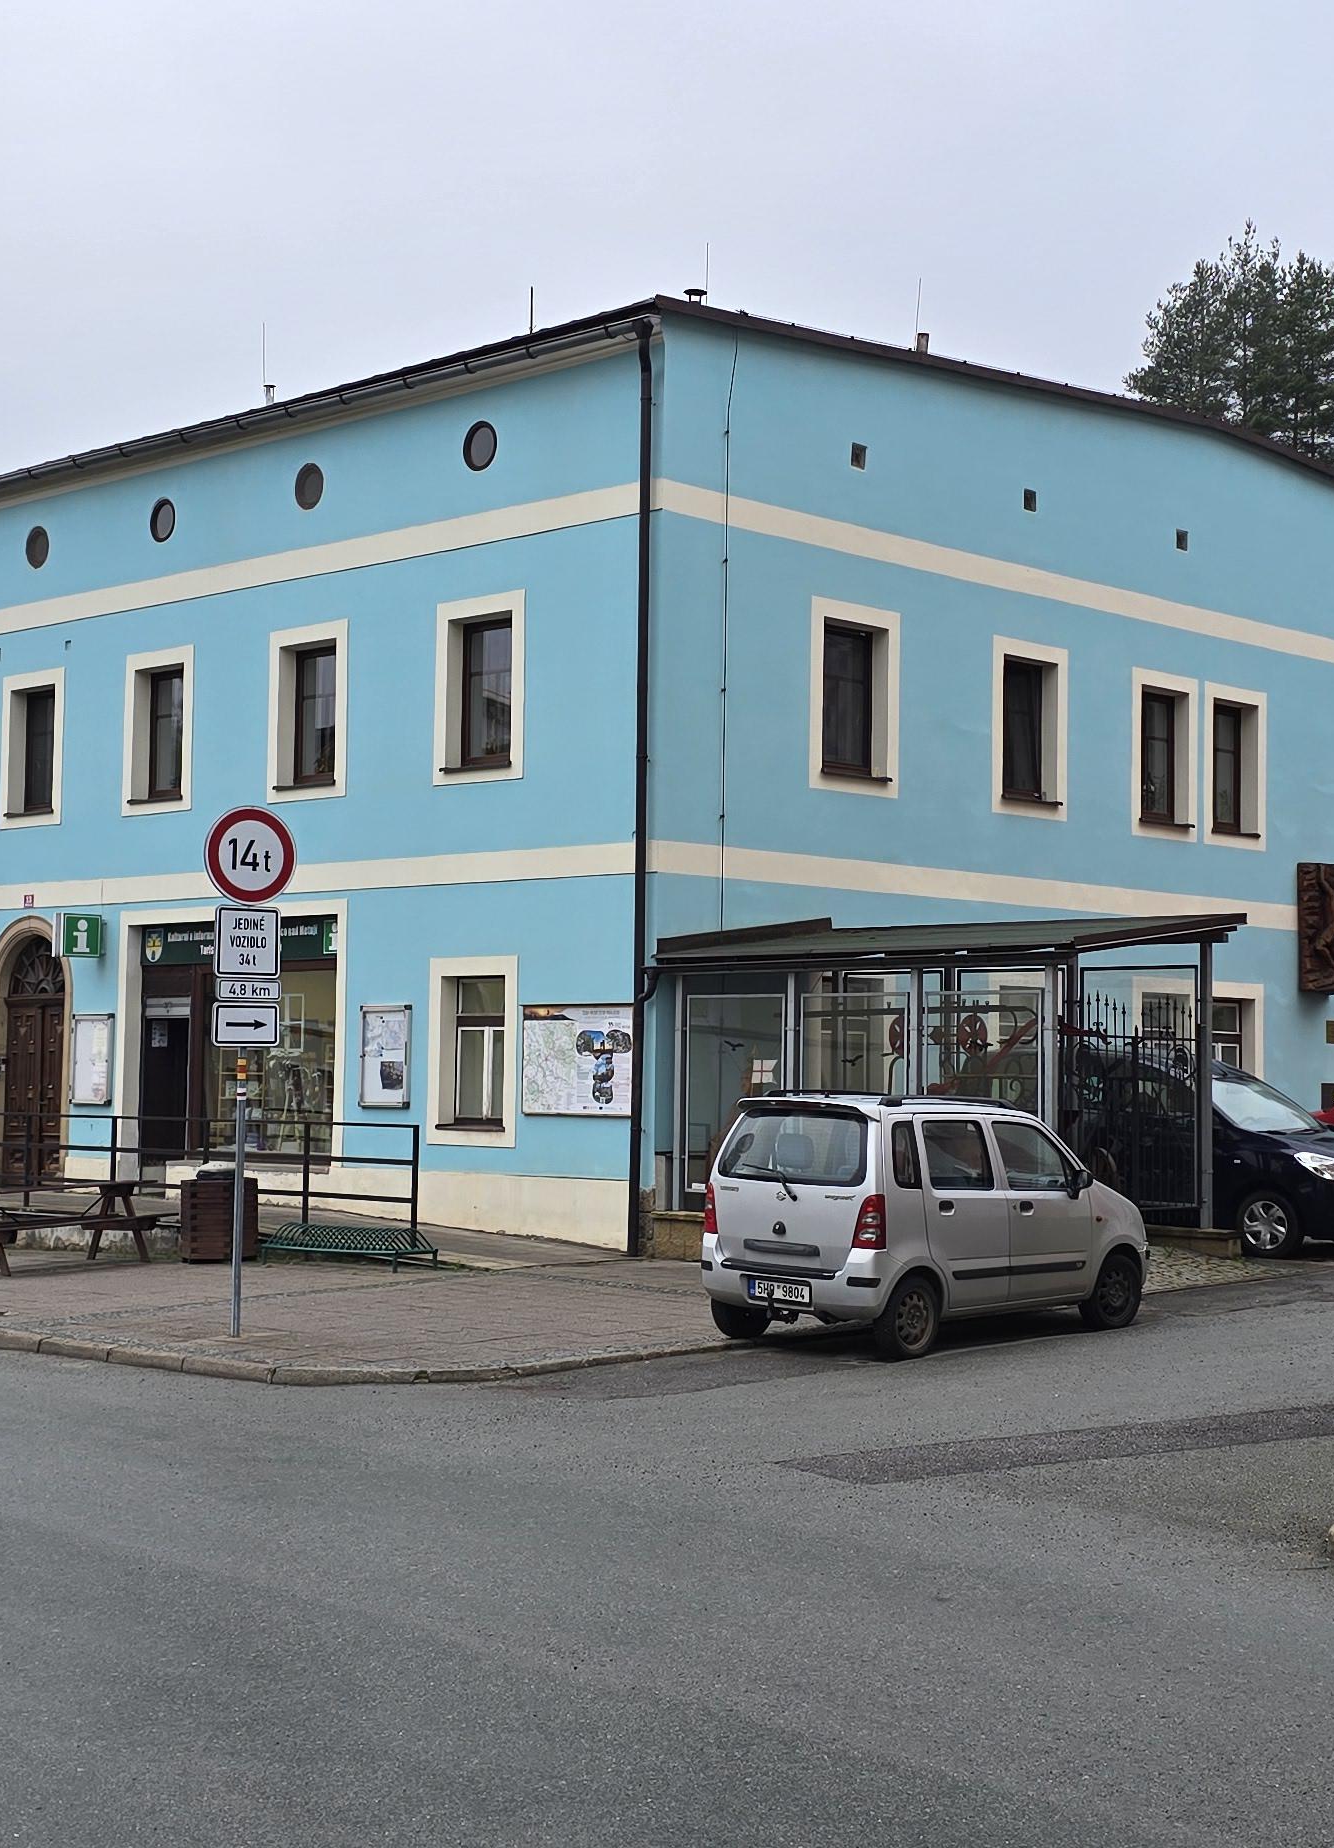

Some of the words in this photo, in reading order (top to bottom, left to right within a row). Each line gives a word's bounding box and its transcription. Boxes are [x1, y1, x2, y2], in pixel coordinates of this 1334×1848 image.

[228, 838, 259, 871] 14
[263, 850, 271, 873] t
[232, 916, 265, 931] JEDINÉ
[72, 919, 90, 953] i
[230, 935, 267, 949] VOZIDLO
[238, 953, 251, 966] 34
[252, 953, 257, 967] t
[229, 984, 246, 997] 4,8
[251, 984, 271, 998] km
[782, 1284, 805, 1300] 9804
